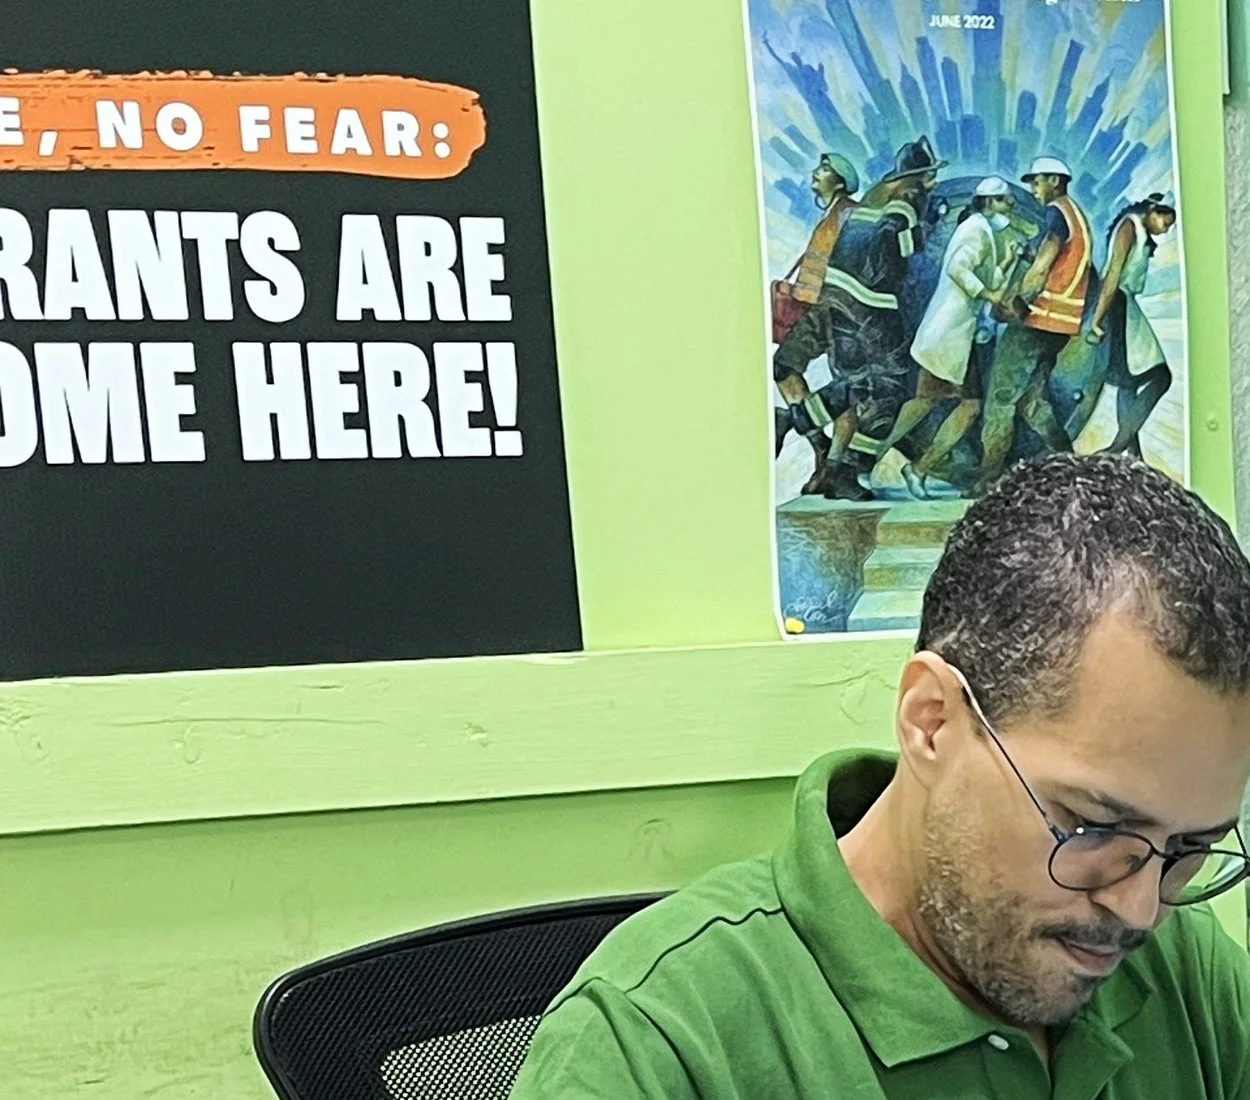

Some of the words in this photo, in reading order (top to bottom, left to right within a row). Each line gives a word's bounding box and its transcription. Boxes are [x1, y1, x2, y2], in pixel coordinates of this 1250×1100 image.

[928, 14, 961, 28] JUNE
[963, 14, 995, 29] 2022
[95, 100, 204, 151] NO
[238, 105, 452, 158] FEAR:
[336, 214, 512, 321] ARE
[232, 342, 523, 461] HERE!
